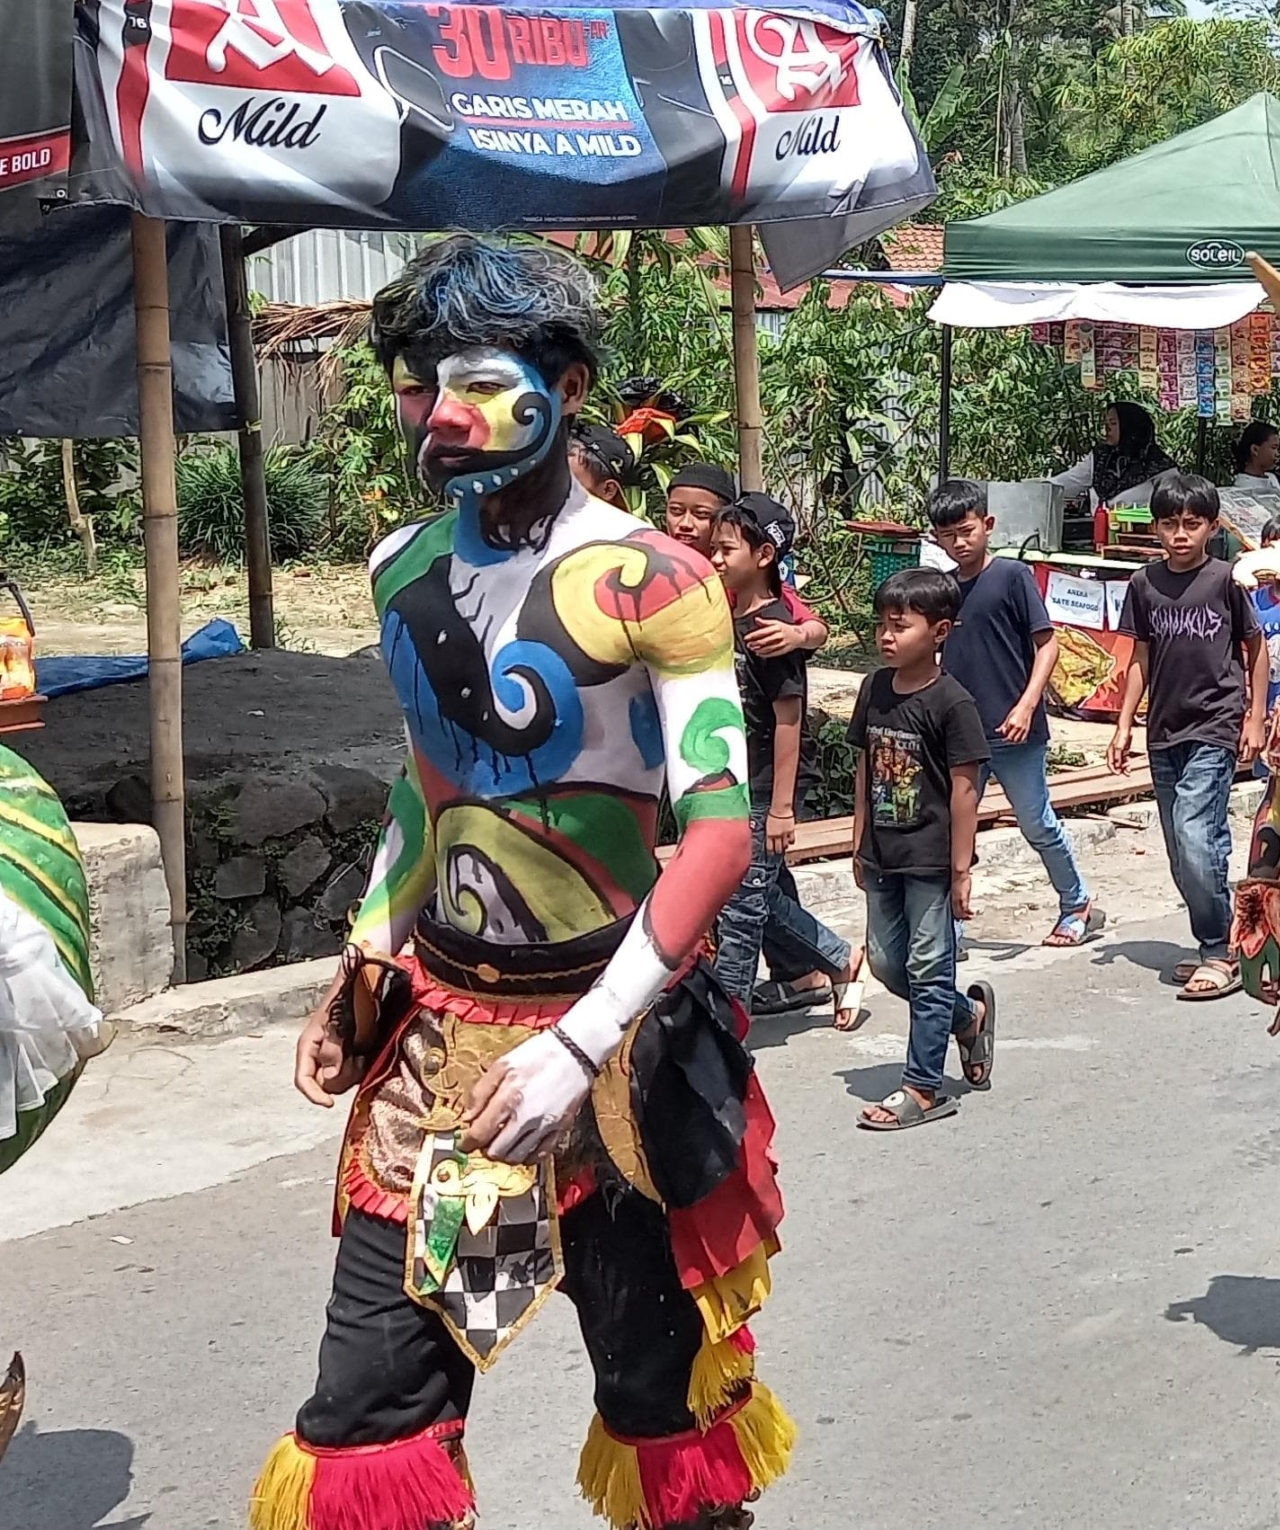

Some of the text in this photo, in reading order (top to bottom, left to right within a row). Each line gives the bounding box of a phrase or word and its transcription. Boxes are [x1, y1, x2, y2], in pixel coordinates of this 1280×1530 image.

[425, 5, 512, 81] 30
[198, 96, 328, 149] Mild
[450, 93, 629, 122] GARIS MERAH
[468, 128, 643, 158] ISINYA A MILD
[775, 114, 842, 161] Mild
[11, 148, 51, 173] BOLD
